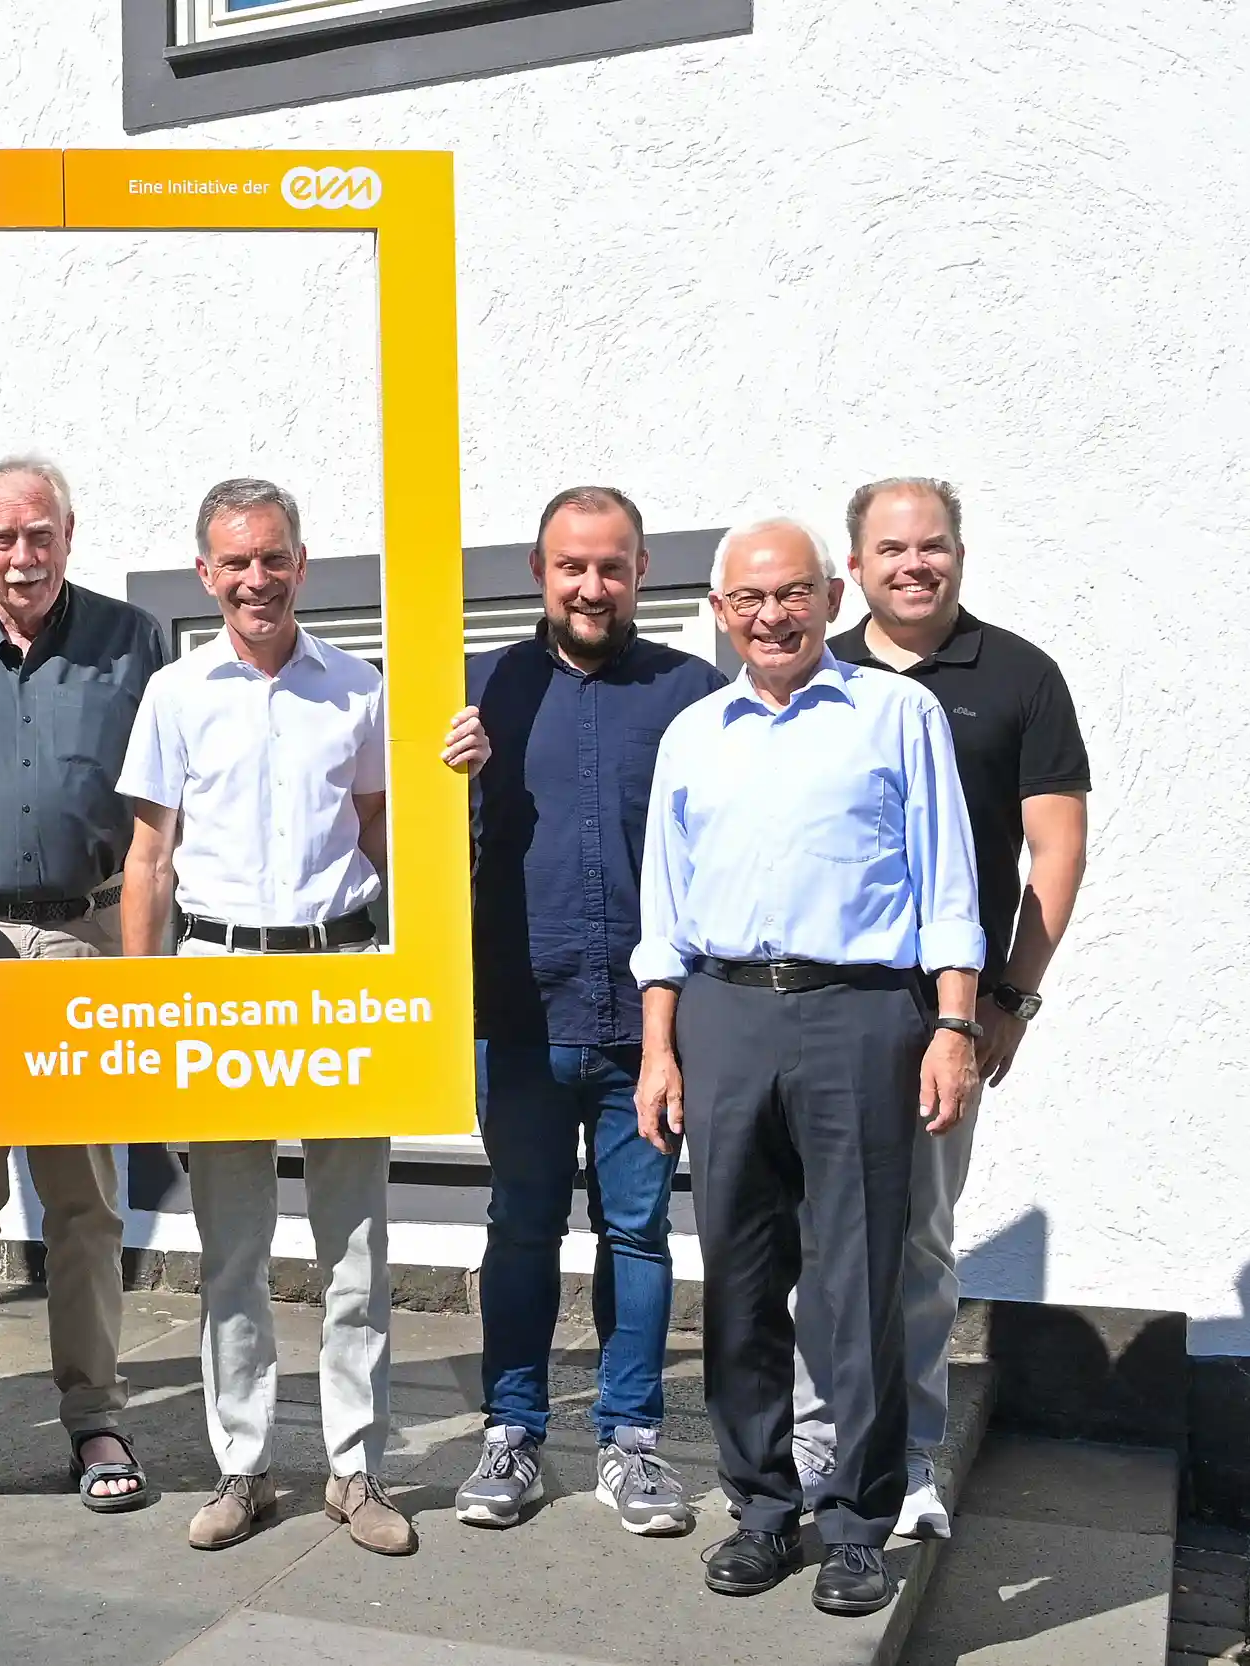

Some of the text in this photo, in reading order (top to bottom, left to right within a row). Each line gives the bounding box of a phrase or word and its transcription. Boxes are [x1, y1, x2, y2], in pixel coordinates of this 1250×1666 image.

[129, 173, 374, 202] Eine Initiative der evm
[66, 988, 433, 1030] Gemeinsam haben
[24, 1039, 373, 1090] wir die Power
